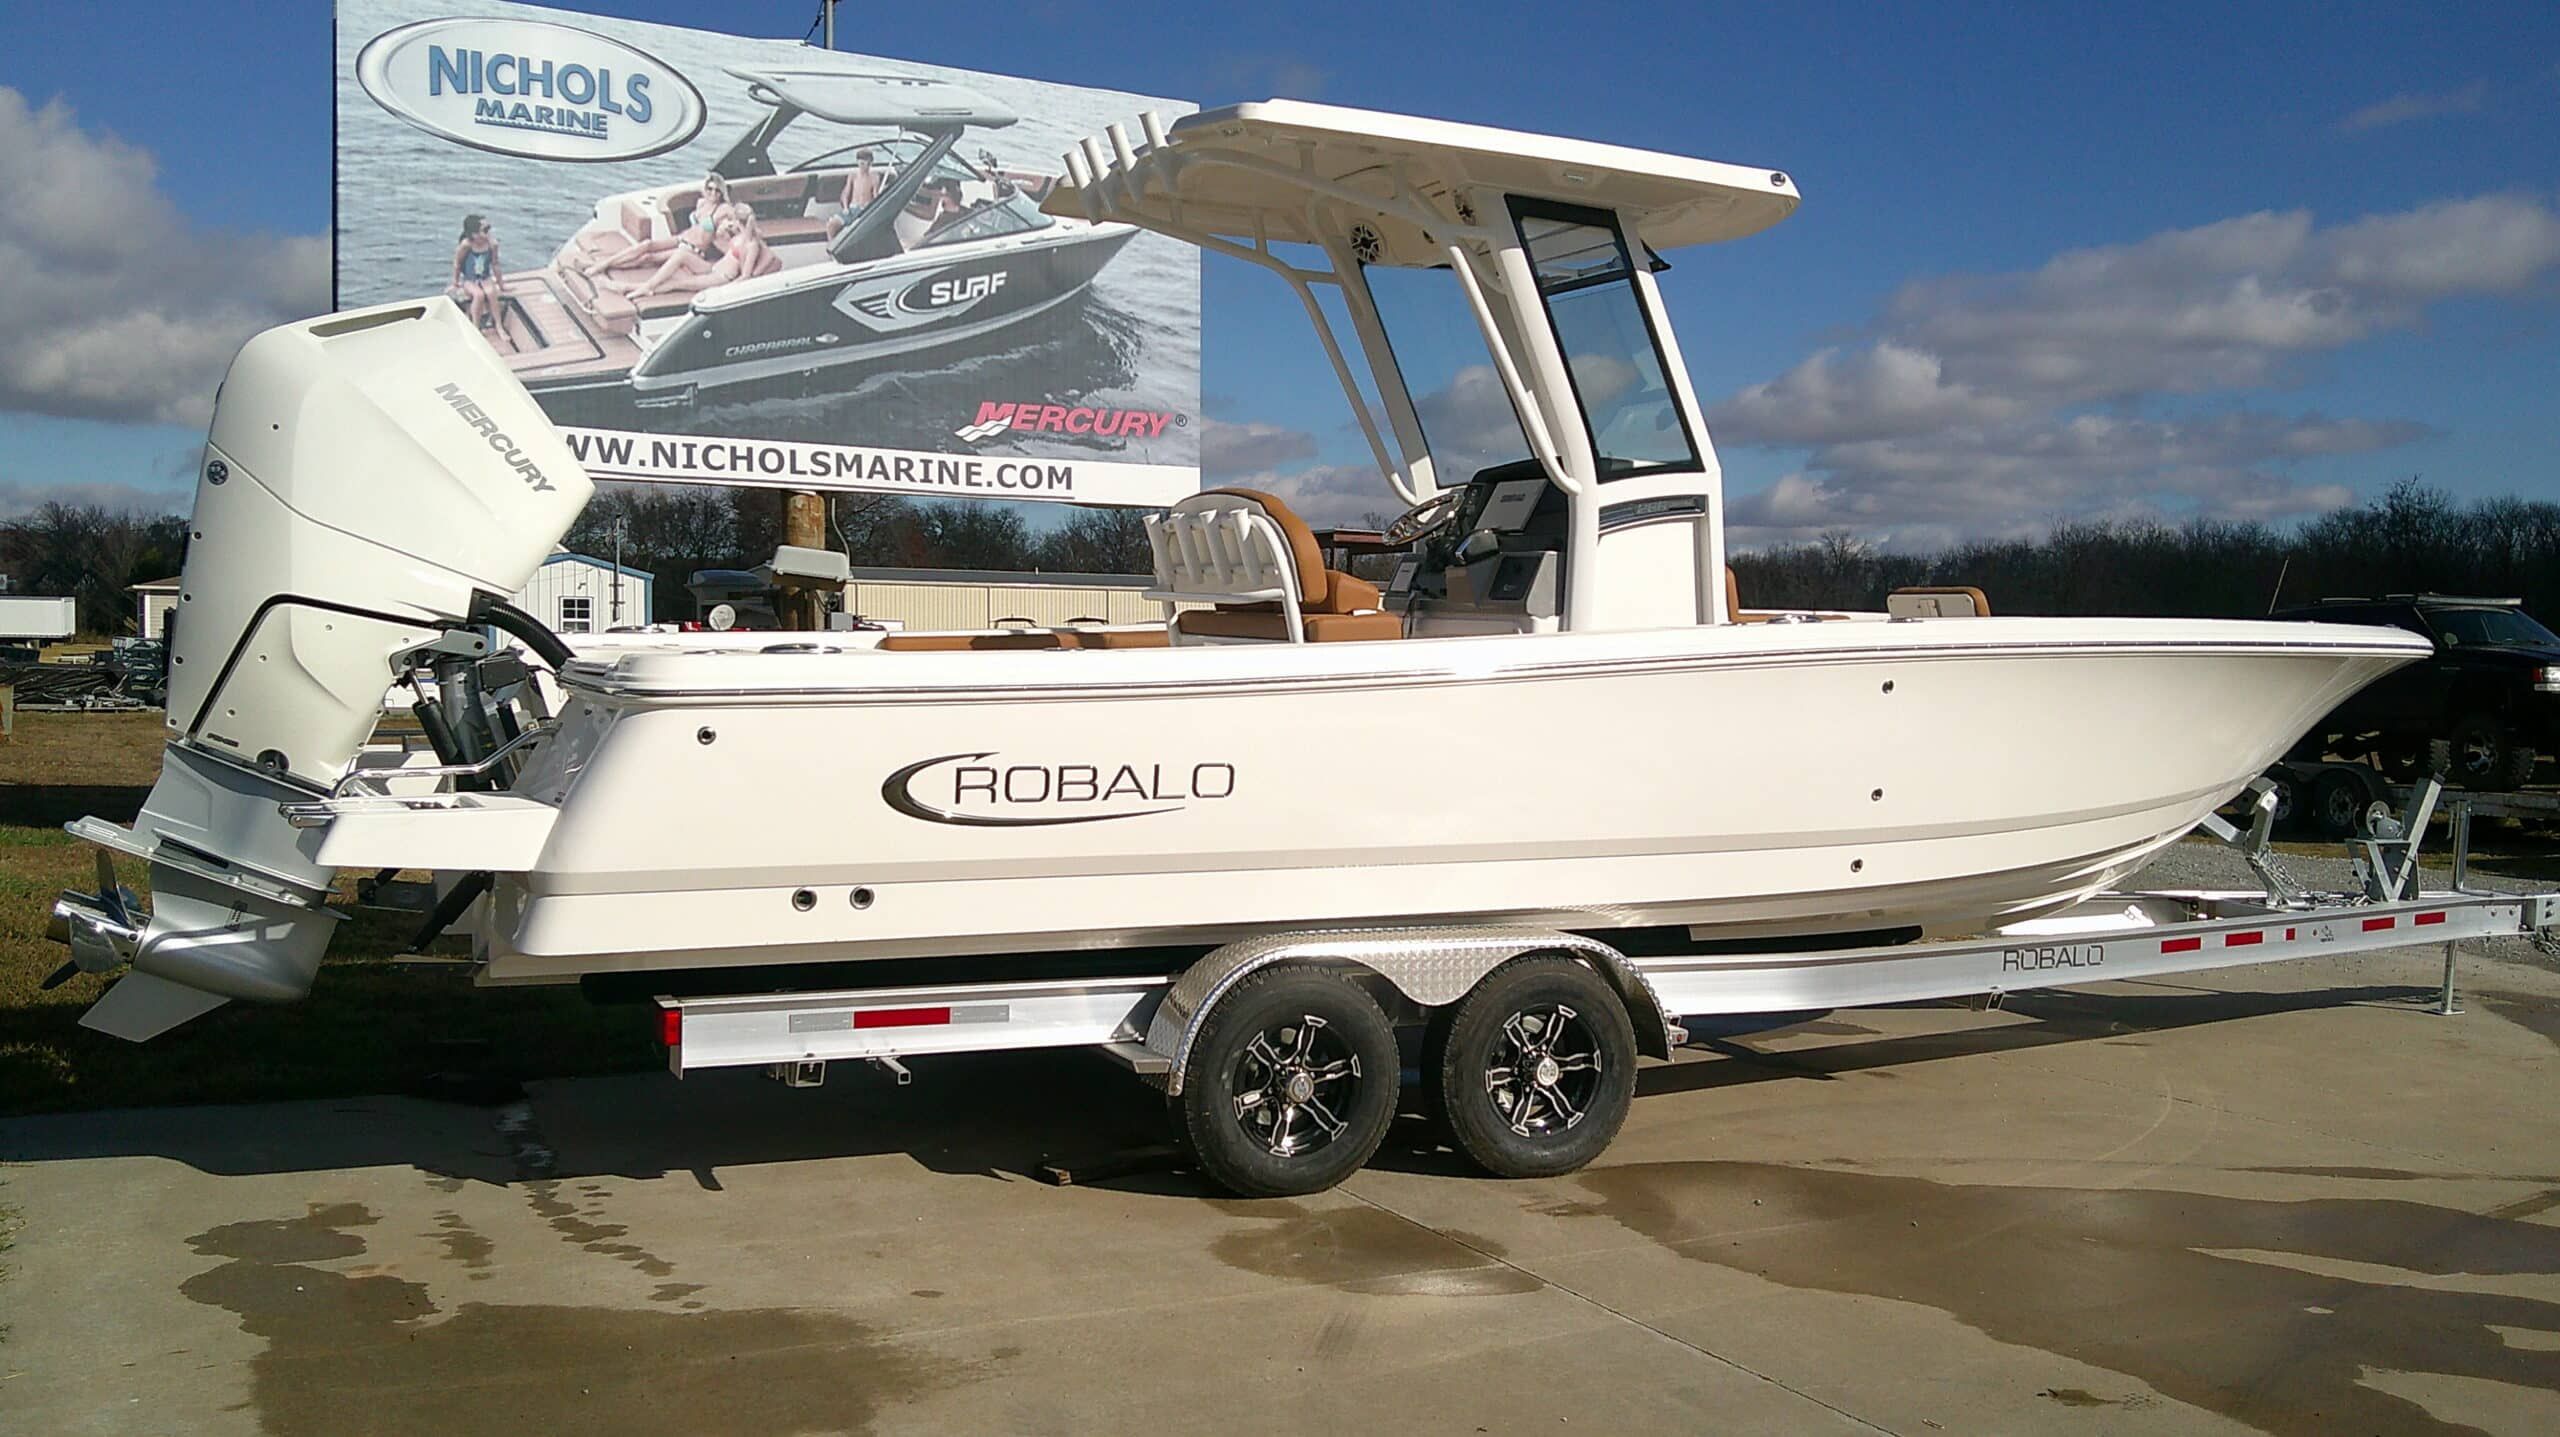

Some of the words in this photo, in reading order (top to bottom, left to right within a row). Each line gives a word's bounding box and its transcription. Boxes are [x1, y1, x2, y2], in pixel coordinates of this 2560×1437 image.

[429, 45, 652, 123] NICHOLS
[475, 98, 608, 132] MARINE
[930, 271, 1007, 305] SURF
[725, 336, 812, 357] CHAPARRAL
[434, 382, 557, 492] MERCURY
[954, 763, 1236, 805] ROBALO
[2003, 945, 2104, 971] ROBALO
